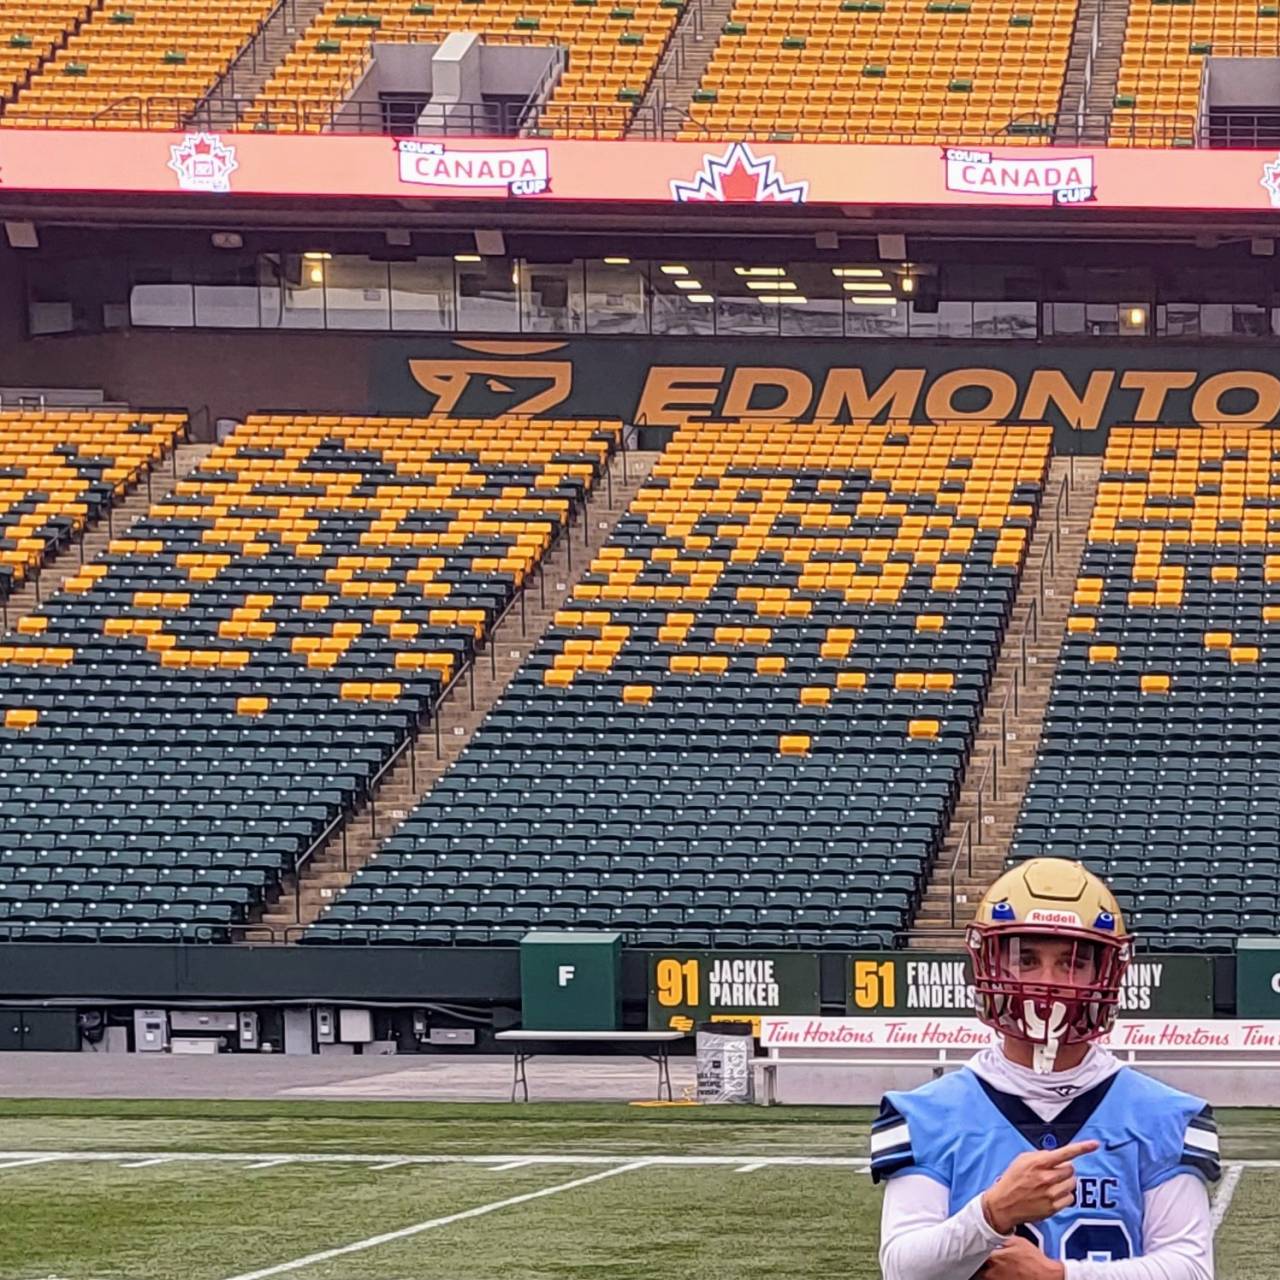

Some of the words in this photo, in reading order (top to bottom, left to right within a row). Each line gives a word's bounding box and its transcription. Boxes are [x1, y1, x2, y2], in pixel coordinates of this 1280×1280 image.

[946, 149, 991, 164] COUPE
[415, 157, 537, 179] CANADA
[962, 165, 1083, 187] CANADA
[511, 181, 546, 195] CUP
[1057, 188, 1091, 203] CUP
[1032, 912, 1076, 923] Riddell
[559, 966, 575, 986] F
[657, 959, 699, 1006] 91
[709, 960, 775, 983] JACKIE
[907, 962, 966, 985] FRANK
[709, 983, 779, 1006] PARKER
[855, 961, 895, 1008] 51
[907, 985, 975, 1008] ANDERS
[1117, 987, 1151, 1010] ASS
[766, 1021, 799, 1042] Tim
[803, 1020, 874, 1043] Hortons
[884, 1022, 918, 1043] Tim
[920, 1022, 992, 1044] Hortons
[1122, 1024, 1155, 1045] Tim
[1159, 1024, 1229, 1046] Hortons
[1241, 1025, 1275, 1045] Tim
